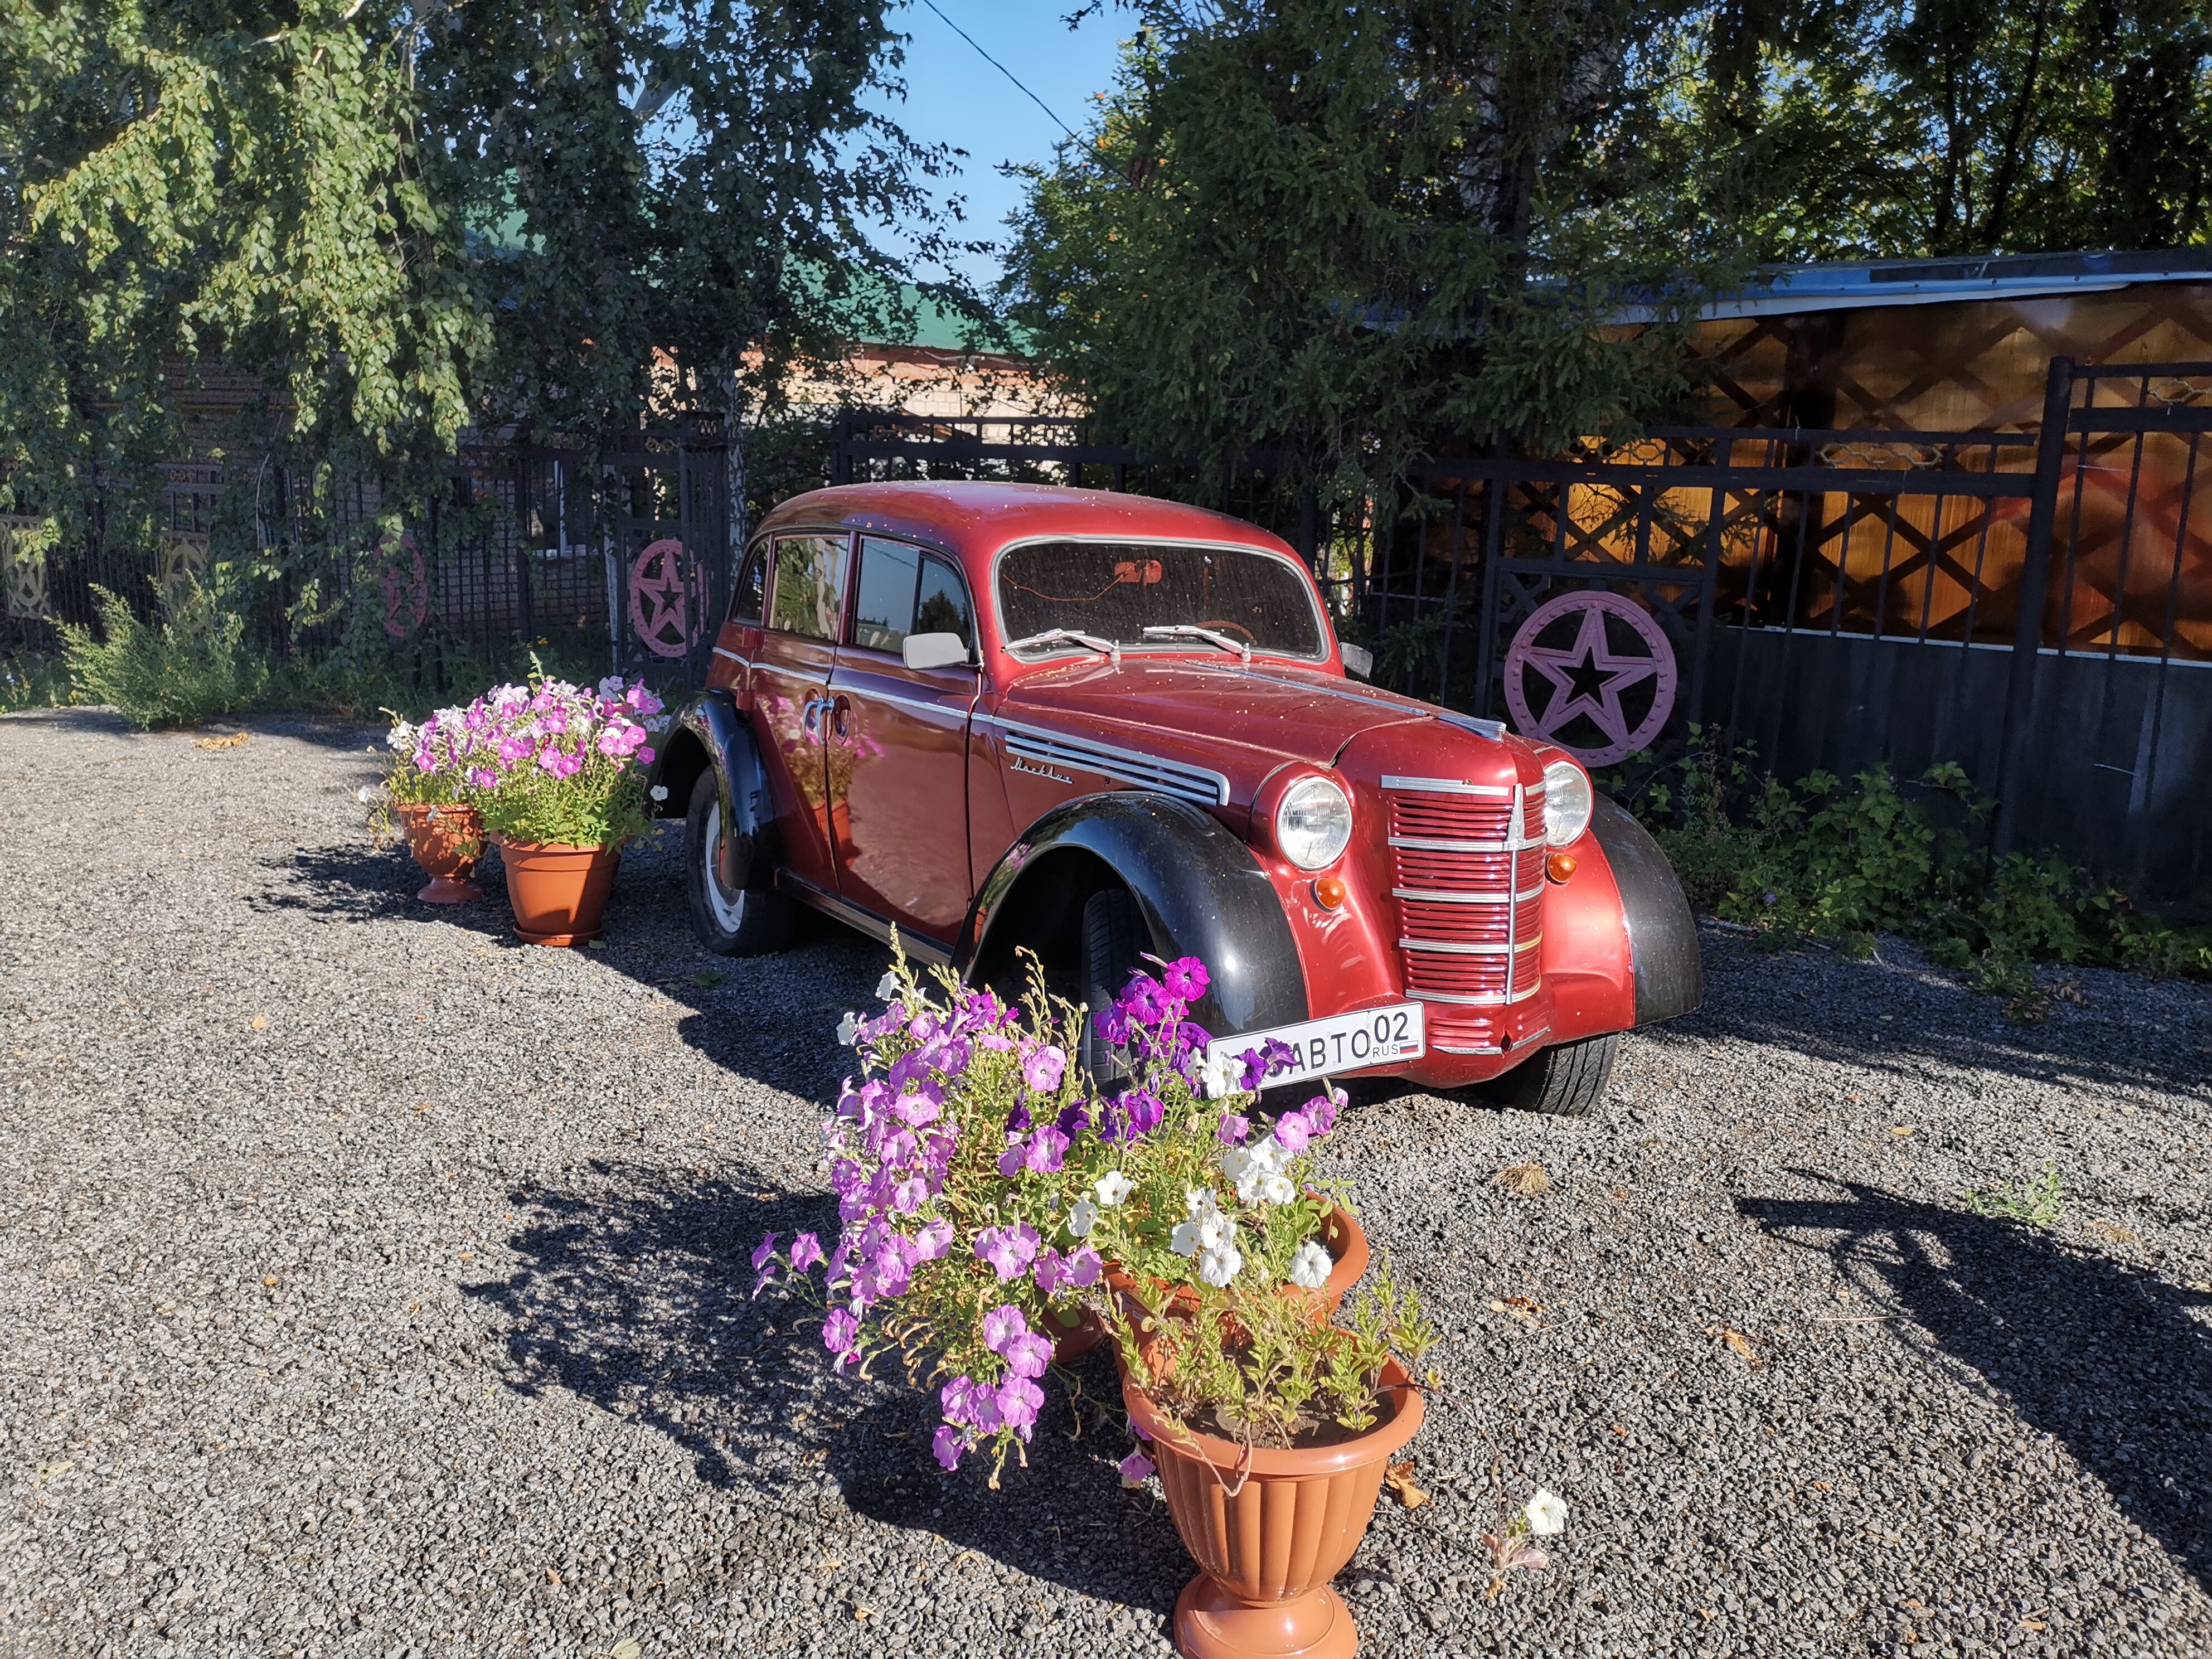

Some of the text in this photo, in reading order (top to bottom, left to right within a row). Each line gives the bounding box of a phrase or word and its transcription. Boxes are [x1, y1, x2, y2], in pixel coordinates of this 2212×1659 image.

[1267, 1011, 1409, 1078] АВТО 02
[1372, 1044, 1398, 1058] RUS
